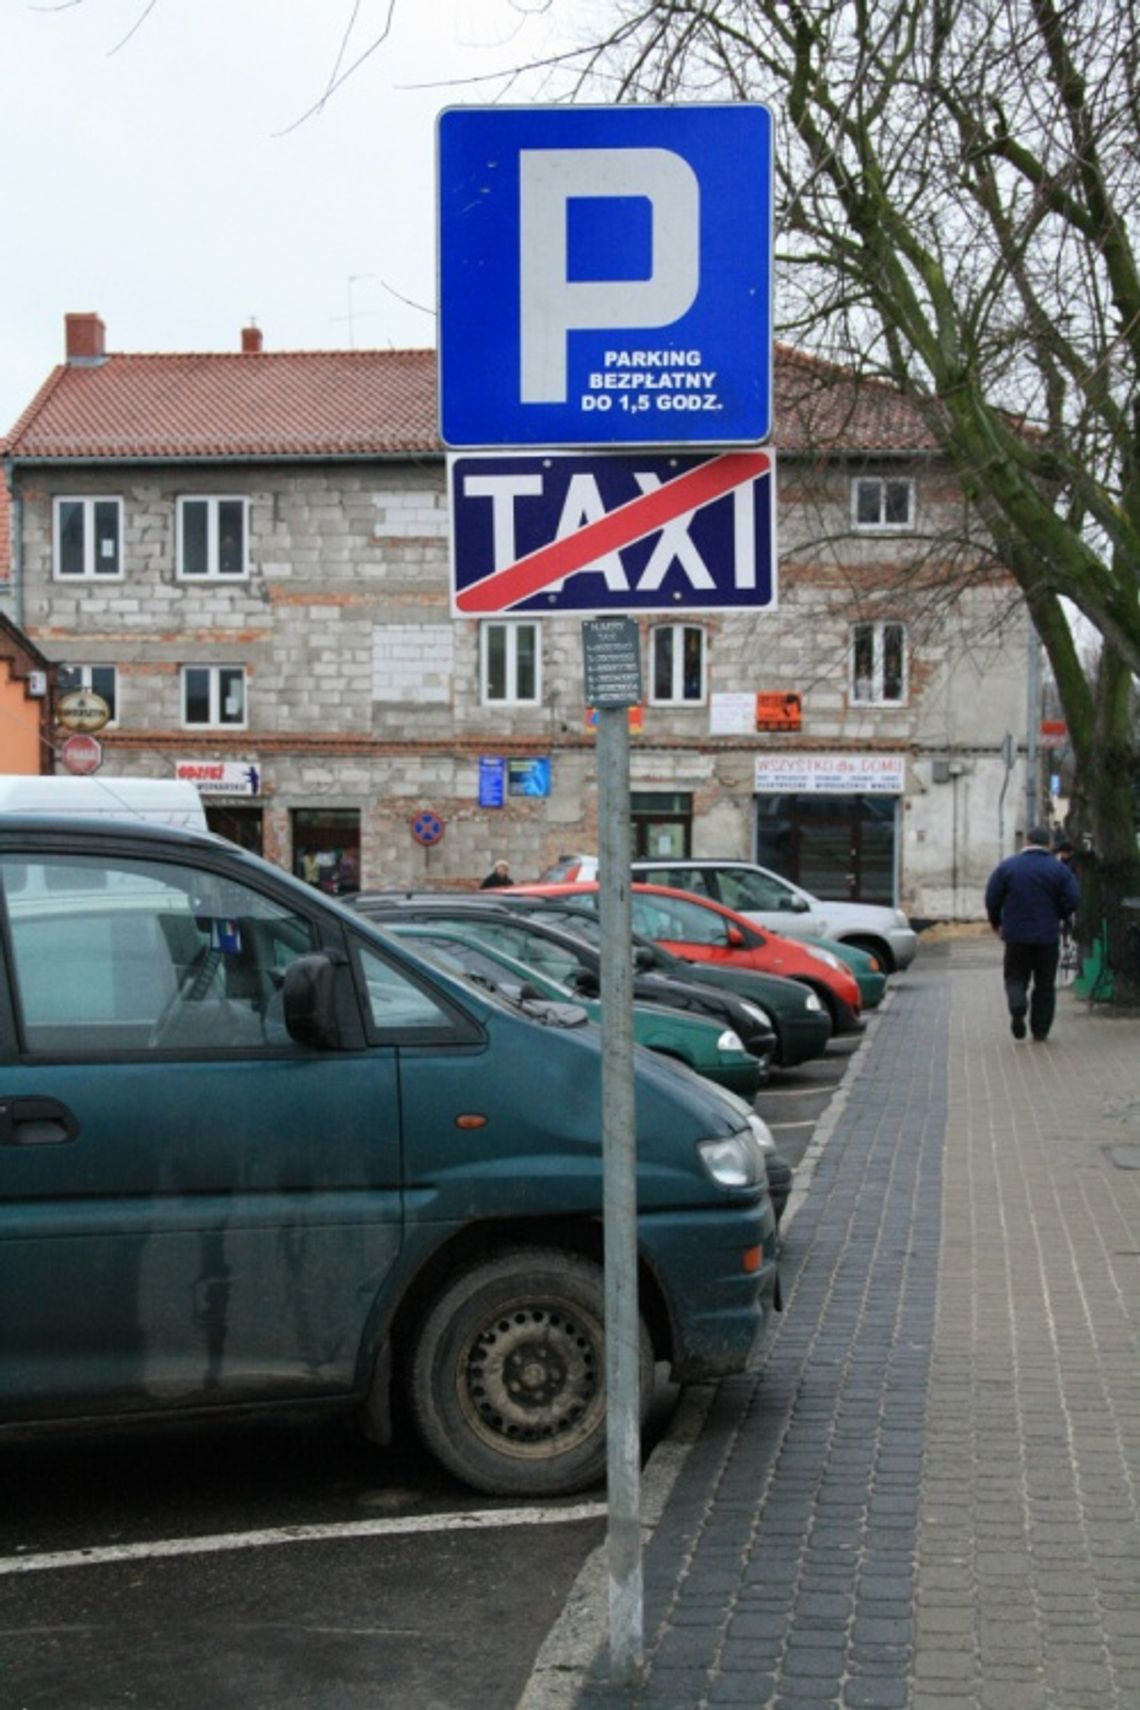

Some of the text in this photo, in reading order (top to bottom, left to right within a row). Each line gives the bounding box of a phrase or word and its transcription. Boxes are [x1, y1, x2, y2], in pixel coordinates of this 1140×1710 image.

[520, 148, 700, 403] P
[604, 350, 702, 367] PARKING
[589, 371, 717, 389] BEZPŁATNY
[581, 394, 724, 414] DO 1,5 GODZ.
[463, 472, 756, 592] TAXI
[758, 759, 833, 772] WSZYSTKO
[862, 759, 902, 772] DOMU
